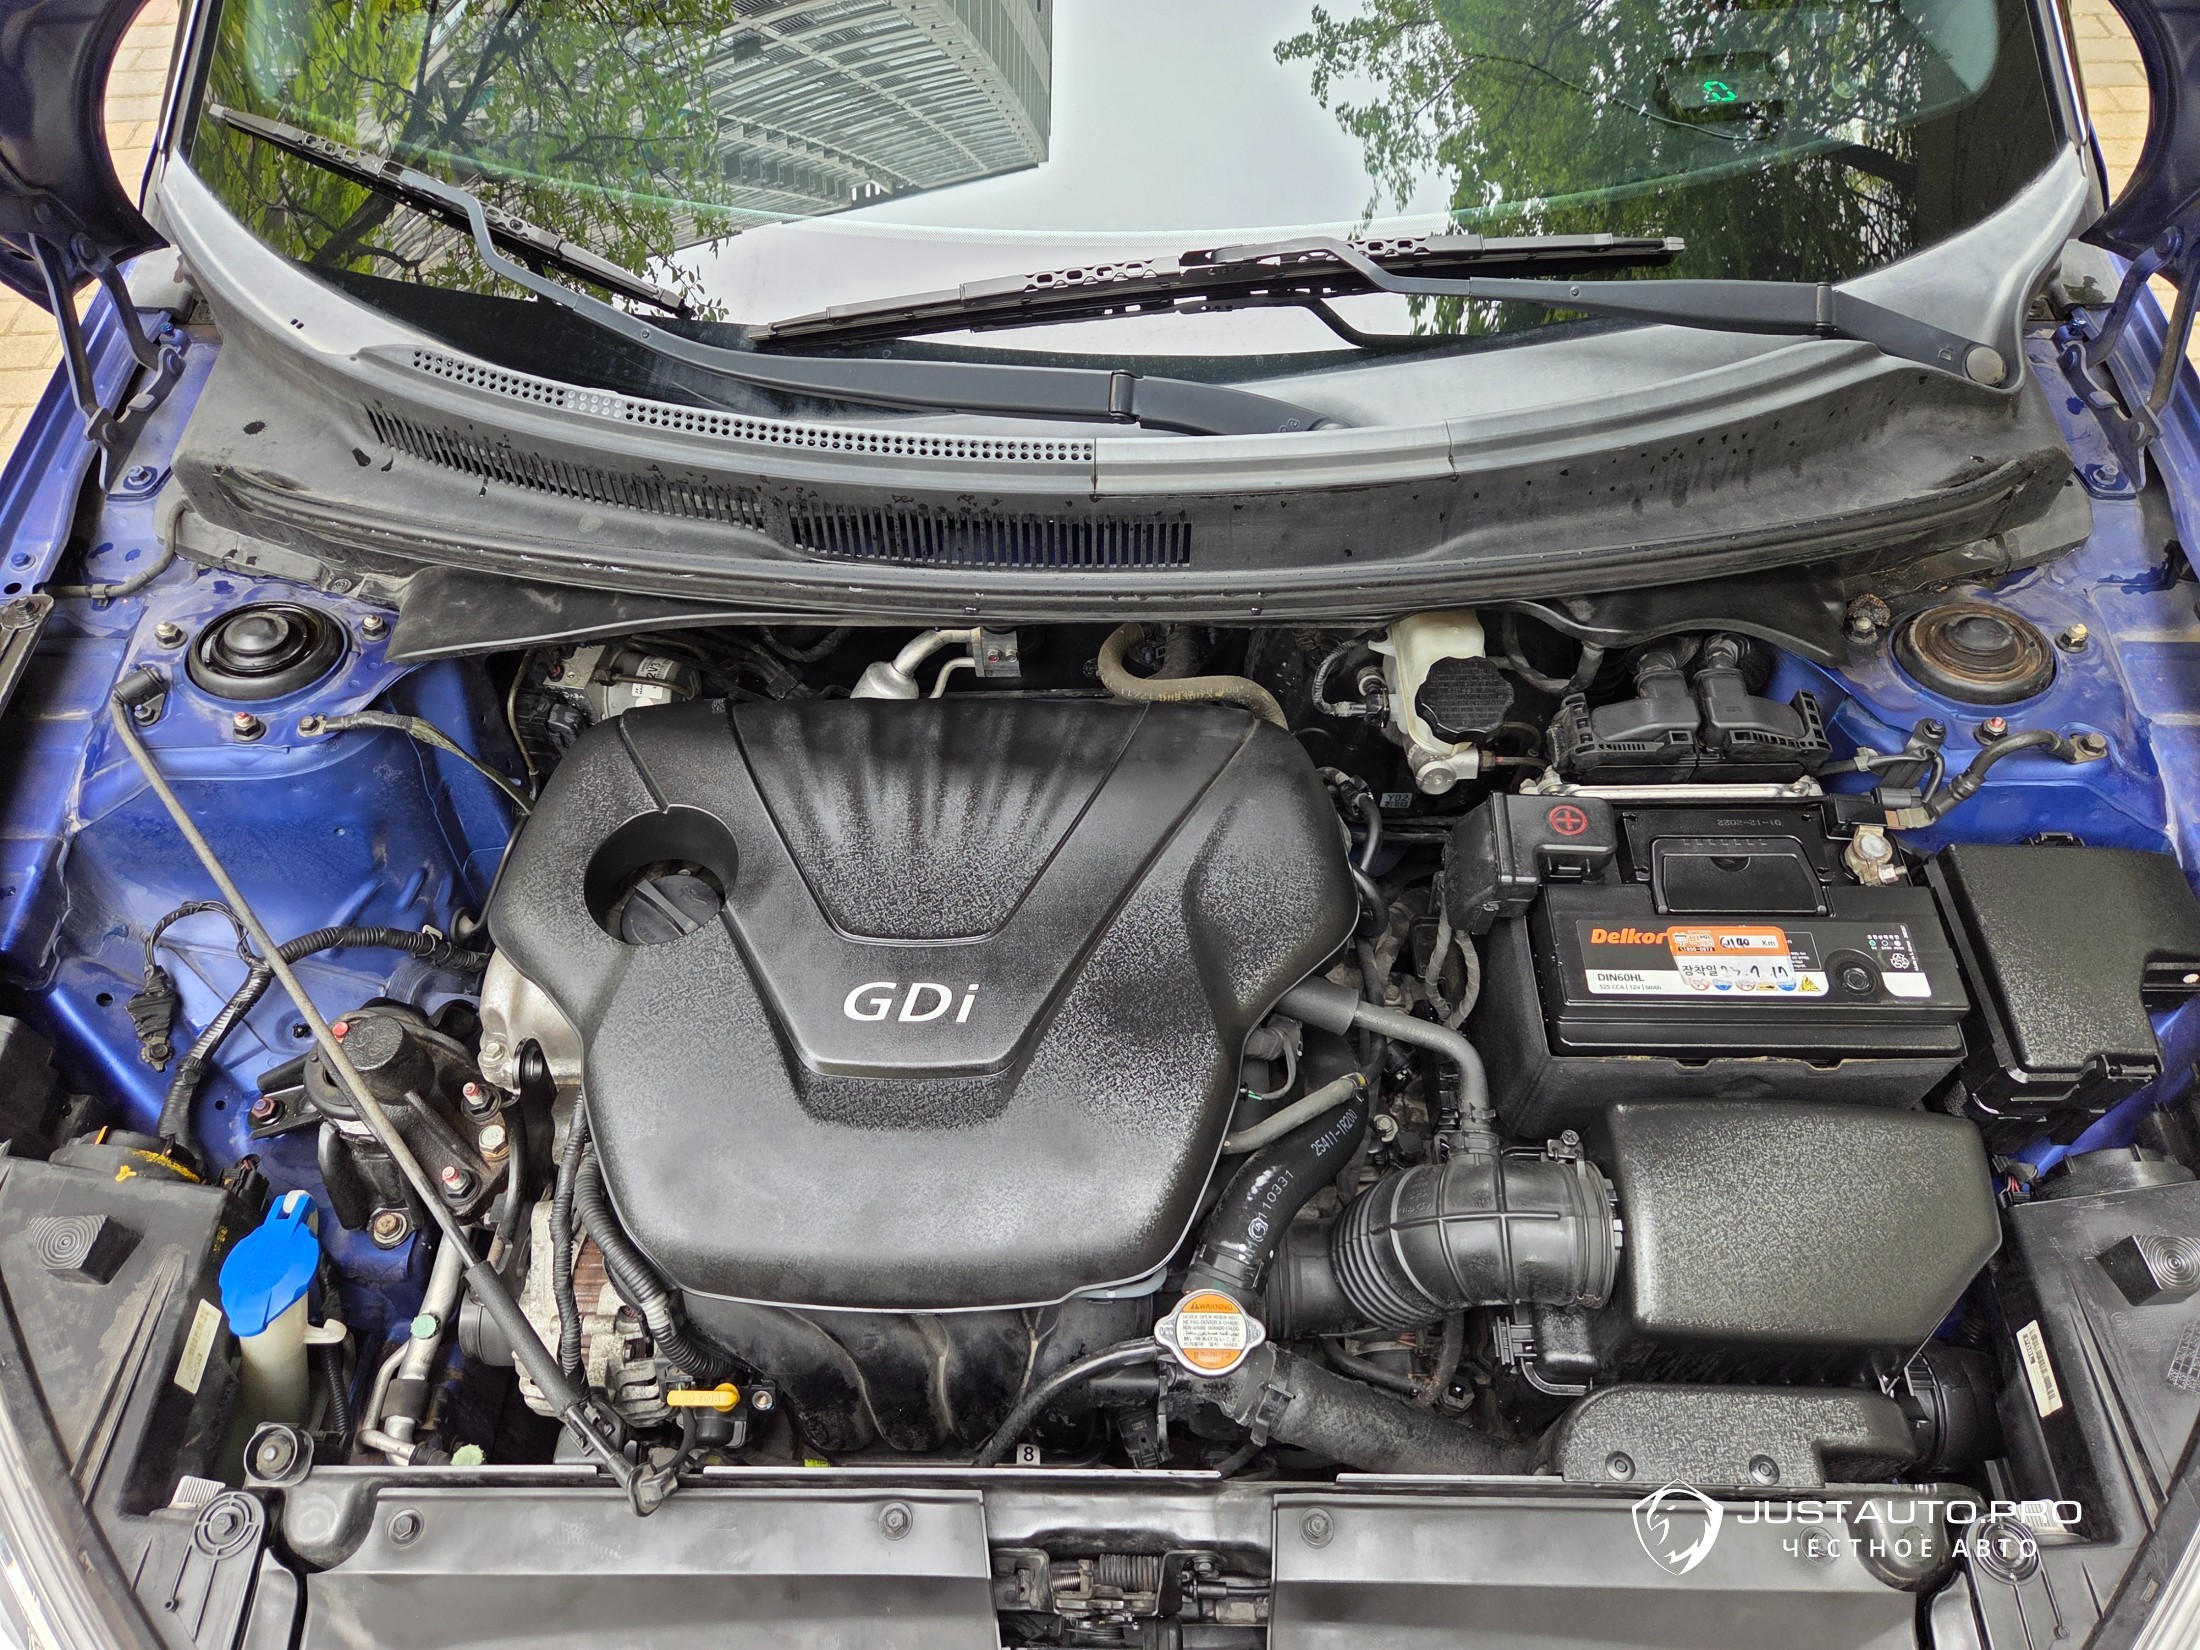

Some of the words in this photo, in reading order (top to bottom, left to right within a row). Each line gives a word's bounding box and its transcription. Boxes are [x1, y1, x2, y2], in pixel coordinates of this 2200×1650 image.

[1591, 928, 1668, 944] Delkor
[1597, 973, 1645, 982] DIN60HL
[1682, 965, 1718, 976] 장착일
[843, 981, 980, 1022] GDi
[1310, 1108, 1358, 1157] 25411-1R200
[1257, 1169, 1294, 1219] 110331
[1200, 1303, 1233, 1311] WARNING
[1023, 1446, 1035, 1462] 8
